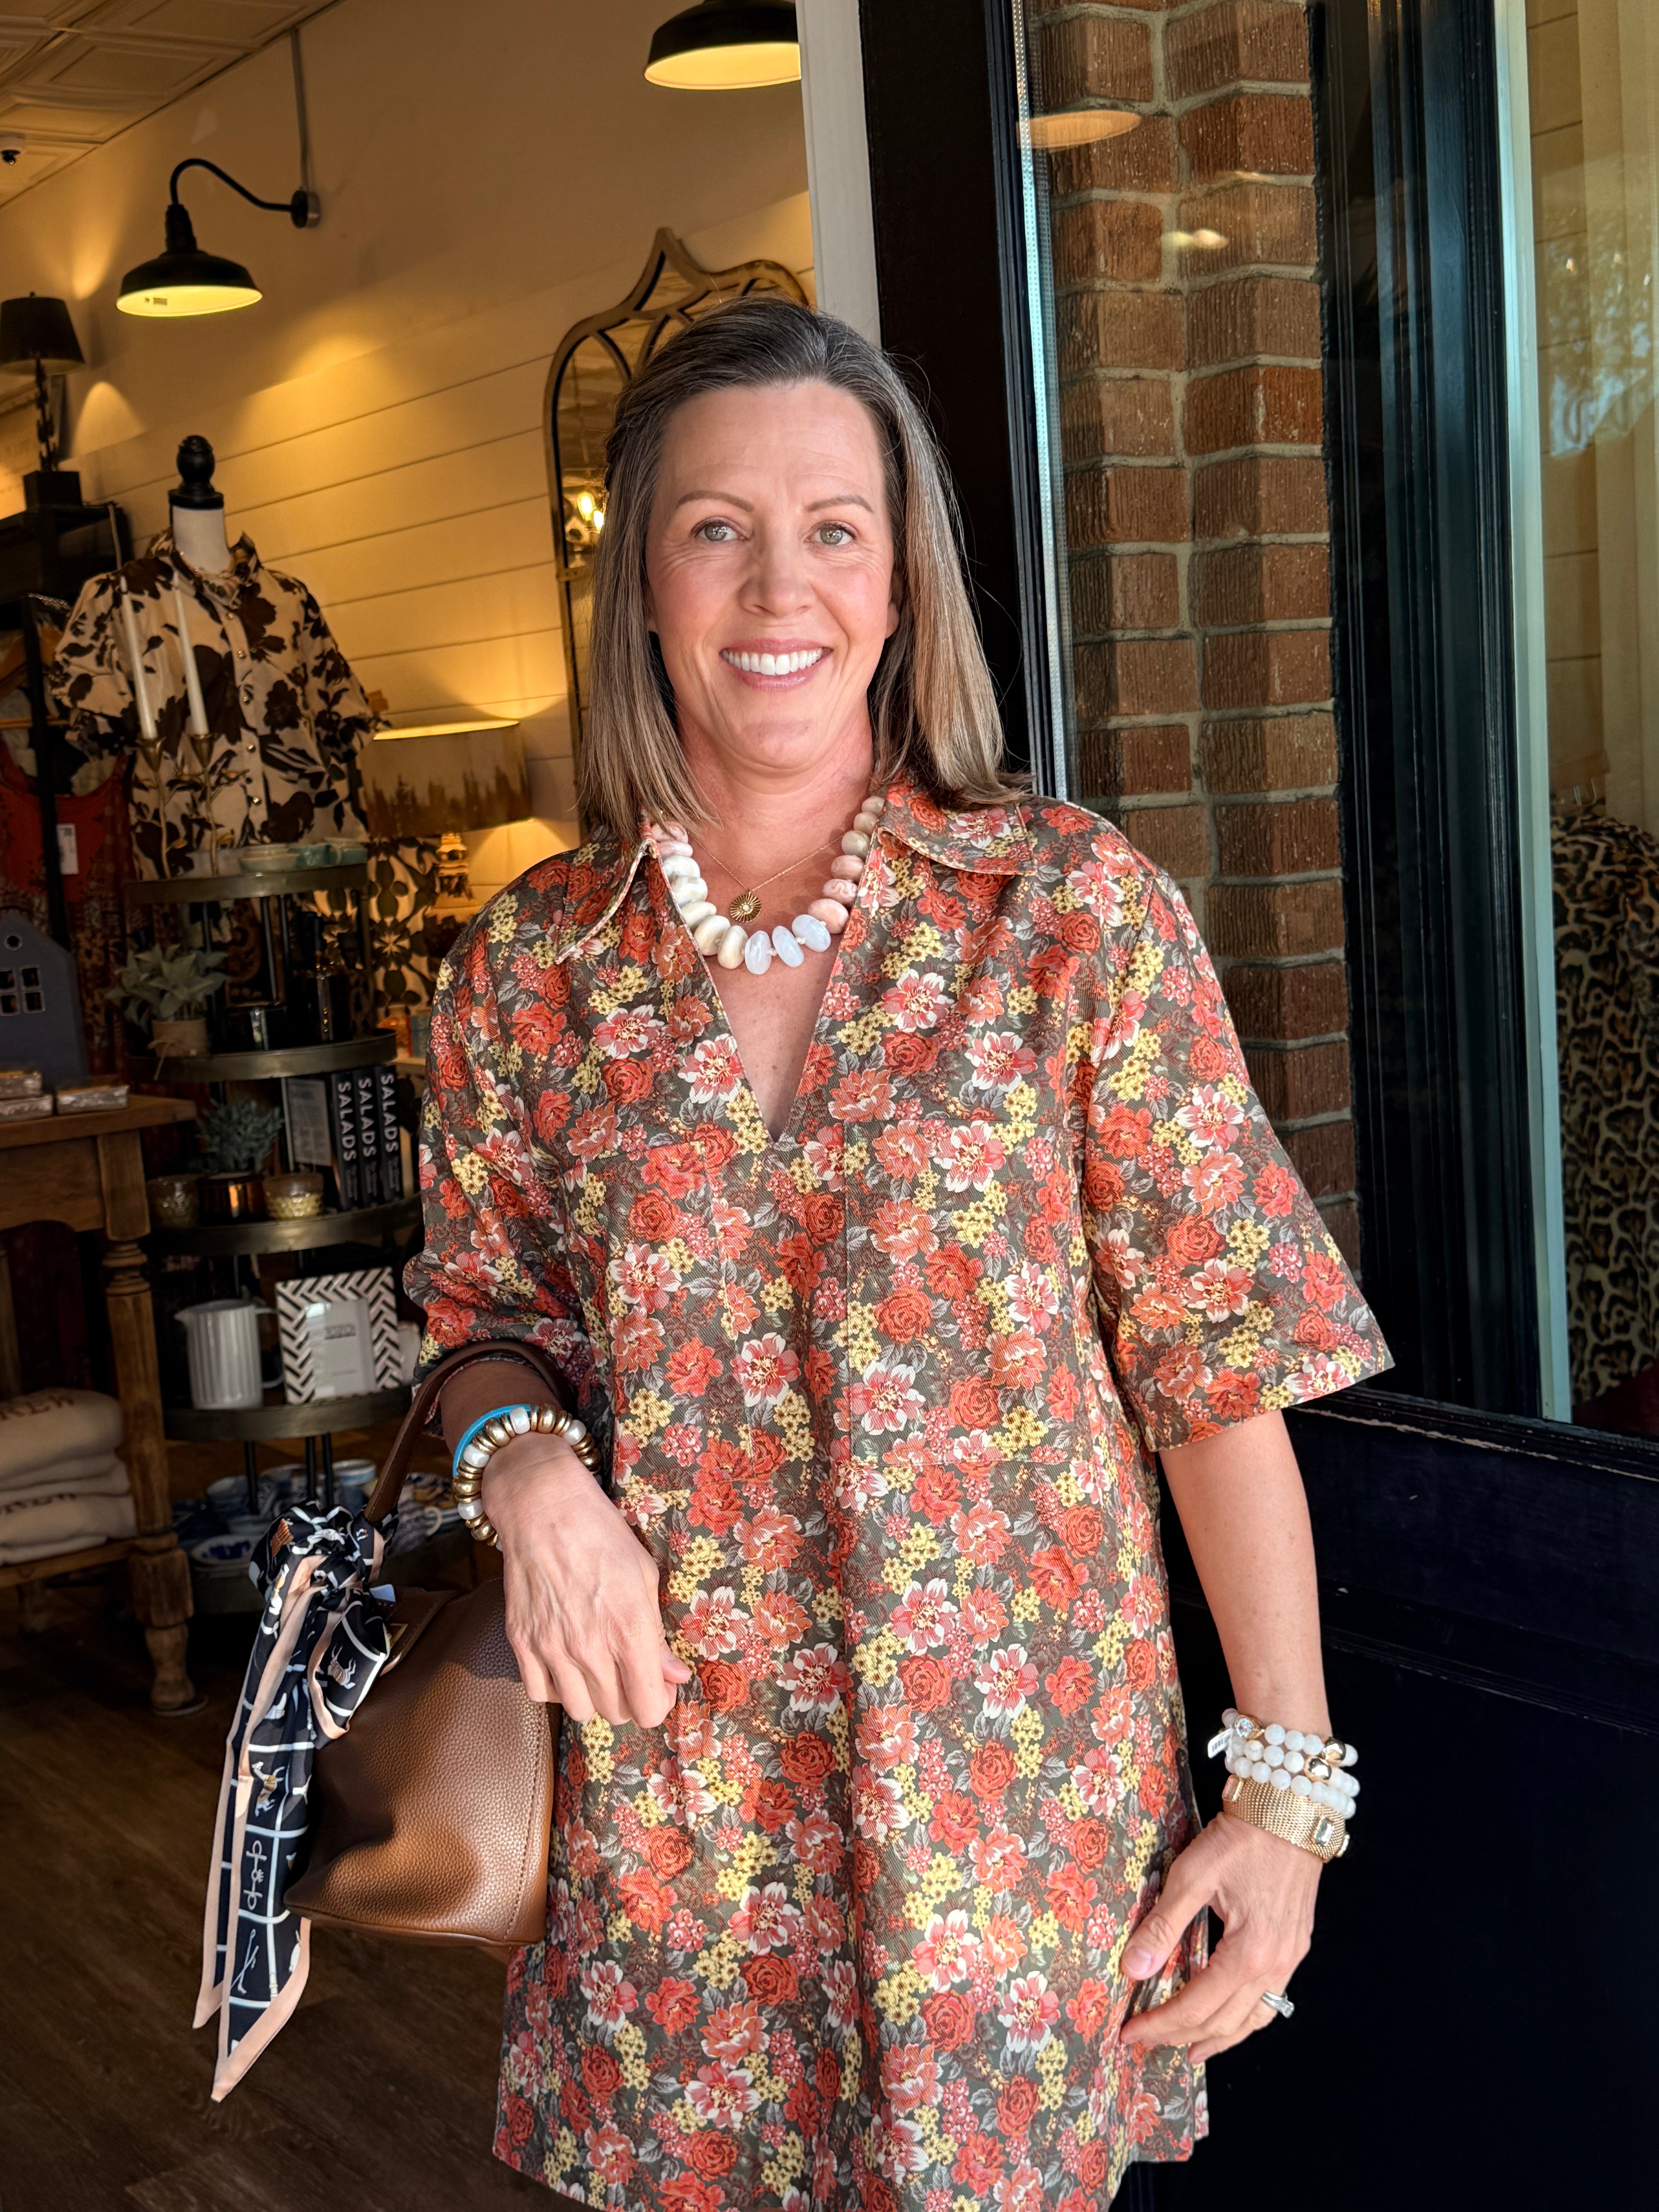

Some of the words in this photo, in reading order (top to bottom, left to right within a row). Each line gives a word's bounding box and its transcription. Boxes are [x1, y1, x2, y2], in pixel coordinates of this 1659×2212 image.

[338, 1081, 357, 1161] SALADS
[358, 1078, 376, 1157] SALADS
[381, 1074, 398, 1152] SALADS
